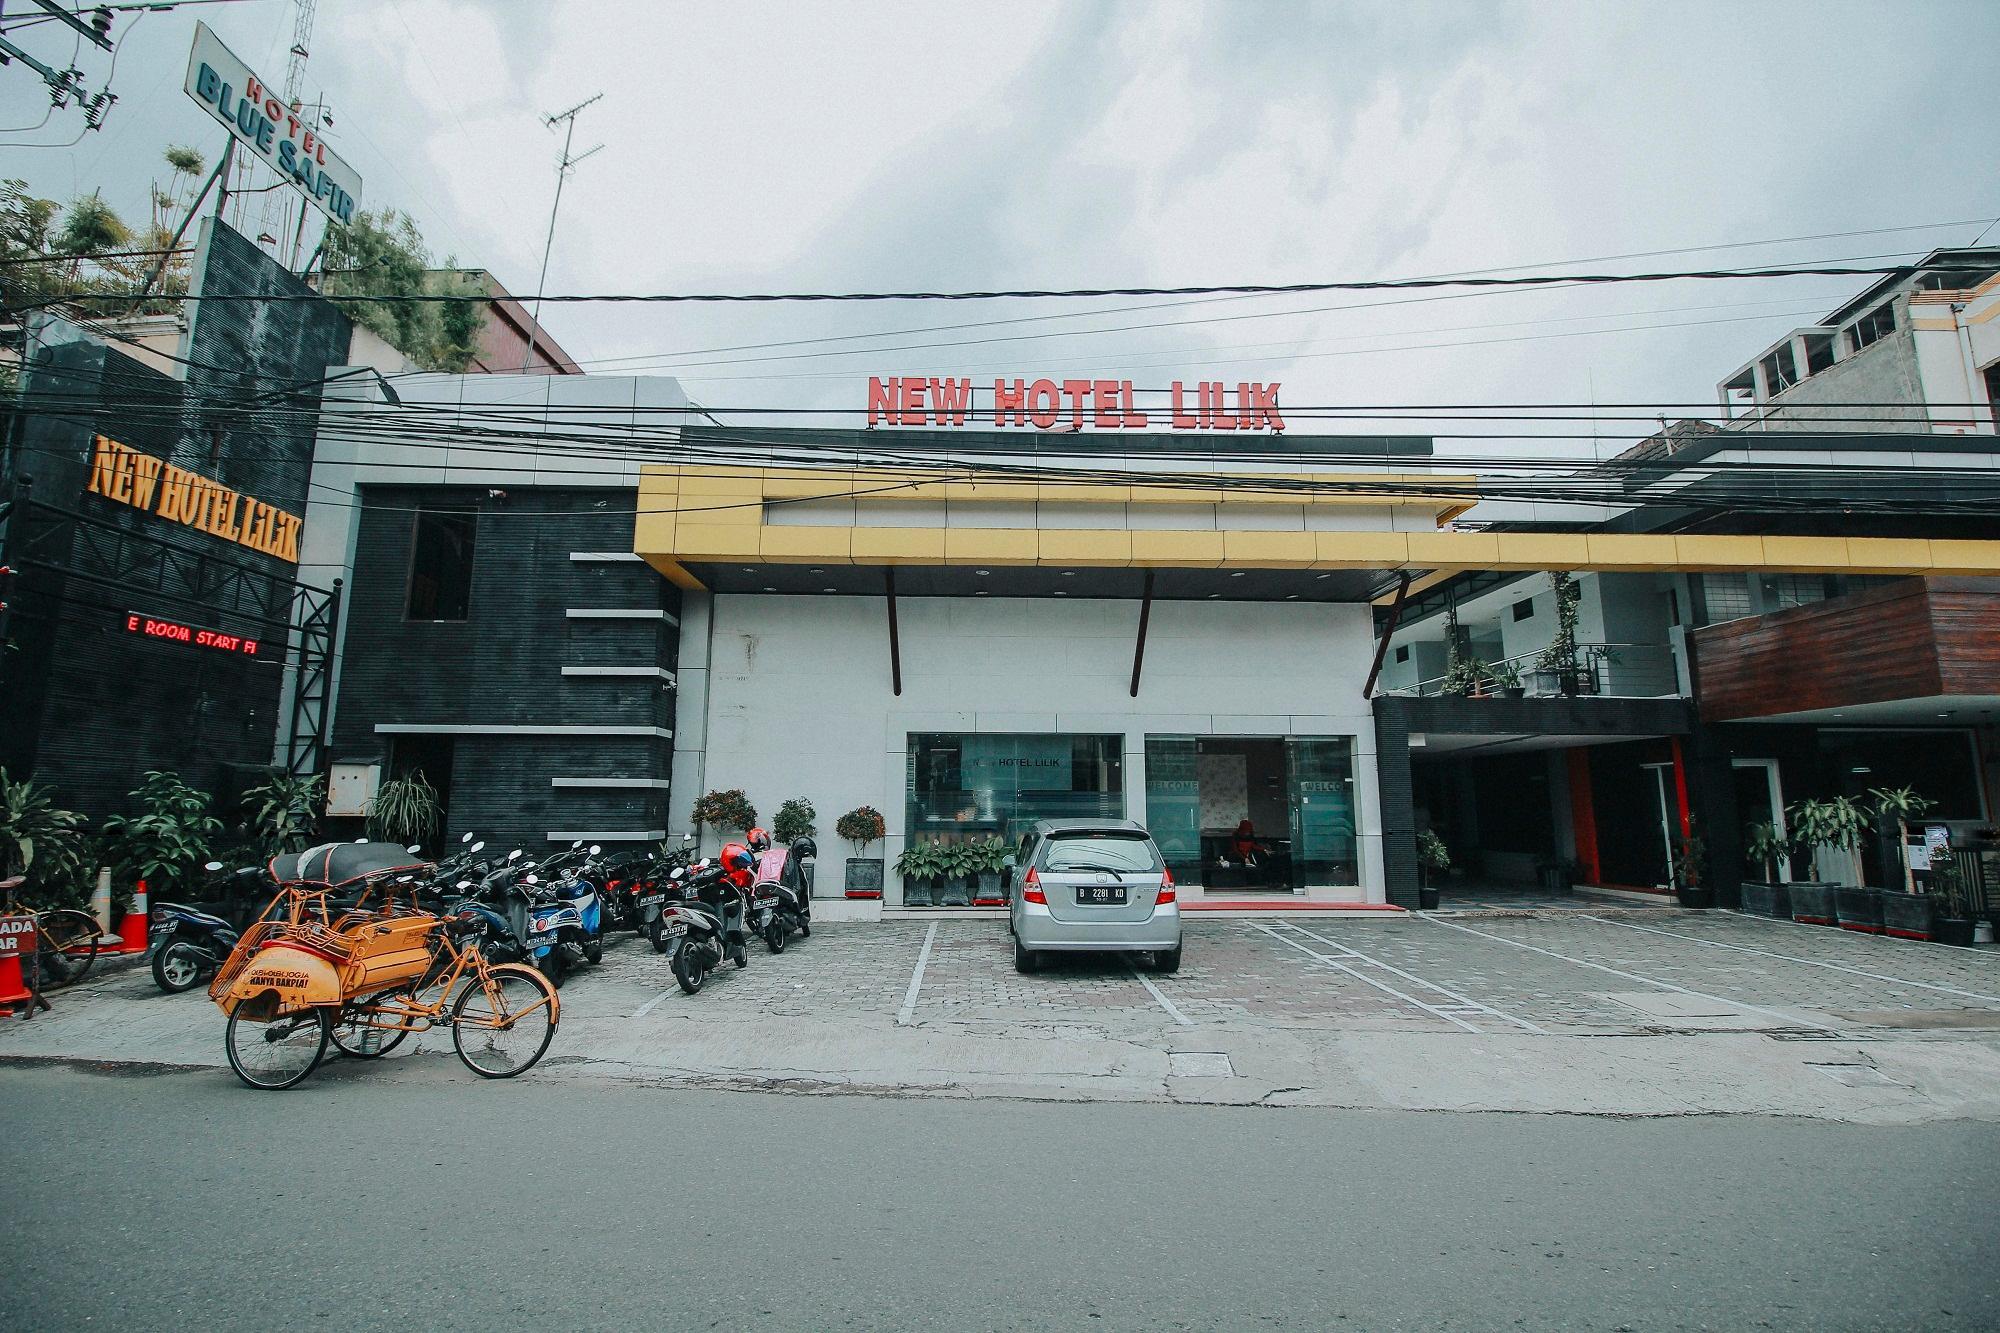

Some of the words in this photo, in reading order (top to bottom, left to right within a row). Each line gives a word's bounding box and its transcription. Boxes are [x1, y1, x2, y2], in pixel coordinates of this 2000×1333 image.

[196, 62, 276, 155] BLUE
[278, 140, 355, 226] SAFIR
[246, 77, 326, 166] HOTEL
[868, 377, 971, 427] NEW
[994, 379, 1148, 429] HOTEL
[1171, 381, 1285, 430] LILIK
[87, 433, 163, 511] NEW
[156, 462, 241, 543] HOTEL
[128, 616, 139, 631] E
[145, 620, 191, 641] ROOM
[196, 631, 240, 651] START
[999, 758, 1033, 767] HOTEL
[1035, 758, 1060, 767] LILIK
[1079, 888, 1085, 898] B
